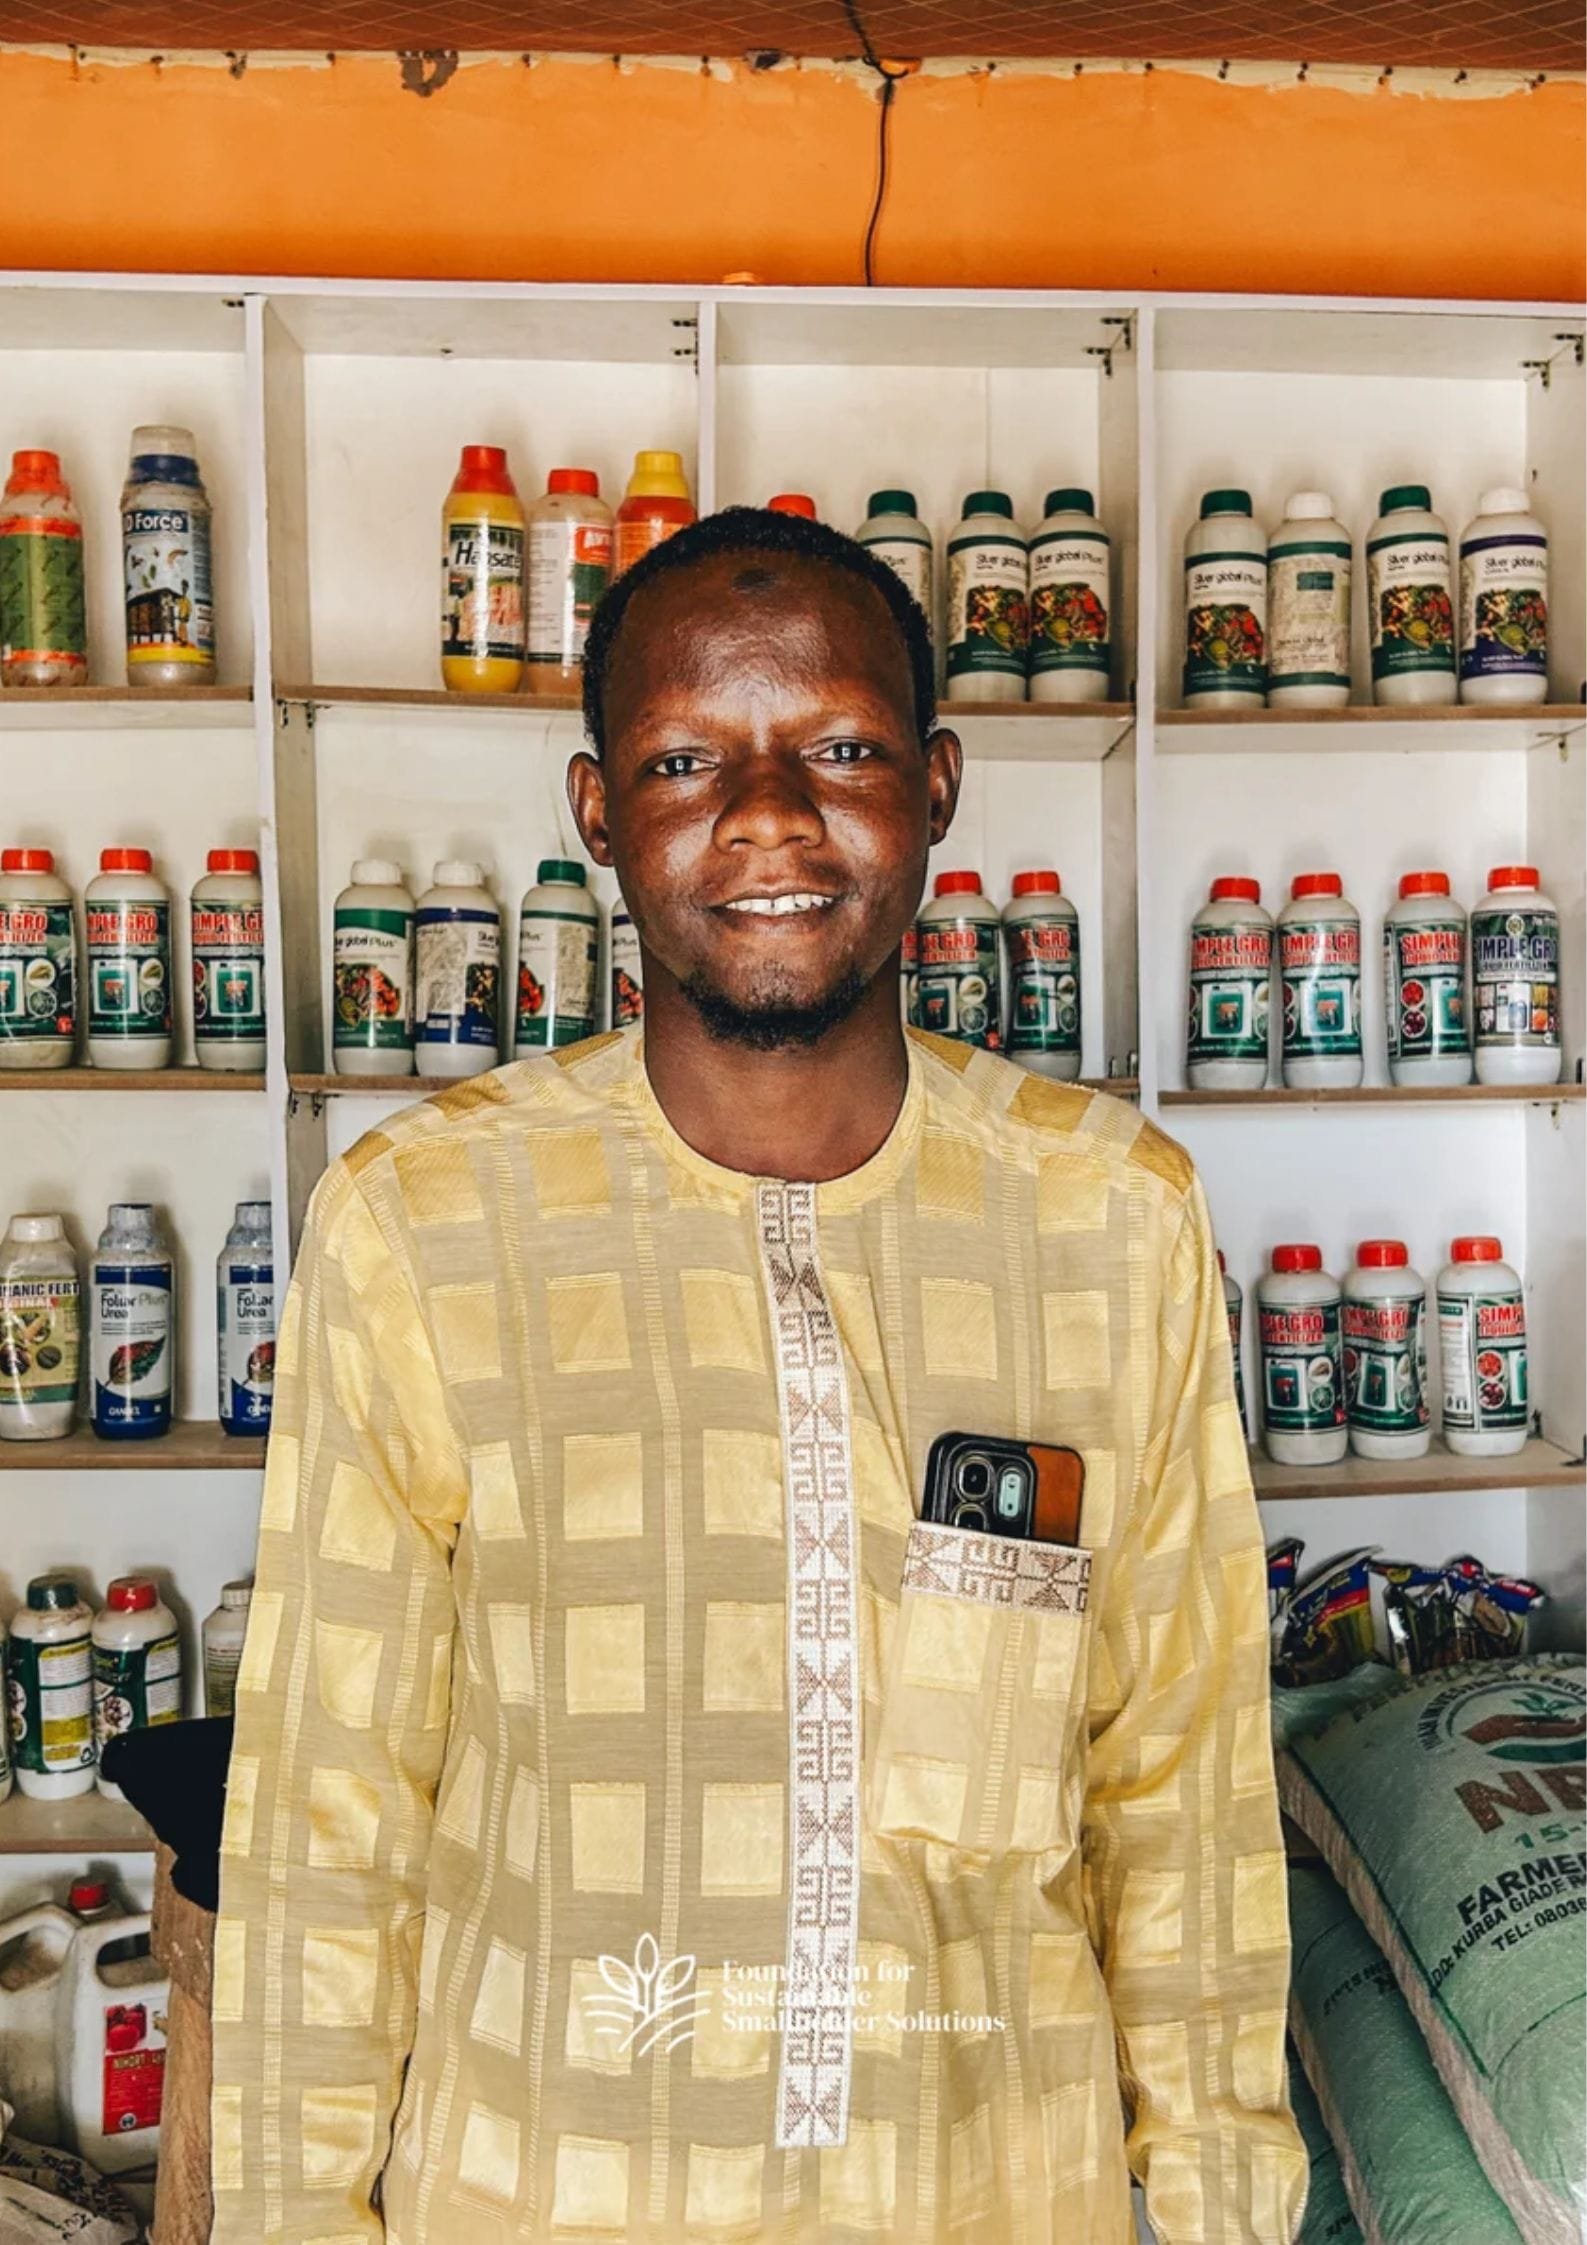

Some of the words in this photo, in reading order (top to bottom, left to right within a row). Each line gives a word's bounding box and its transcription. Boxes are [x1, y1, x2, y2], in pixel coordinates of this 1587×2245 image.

[135, 513, 183, 530] Force
[1452, 1908, 1508, 1960] KURBA
[1508, 1877, 1567, 1914] GIADE
[1491, 1922, 1535, 1951] TEL:
